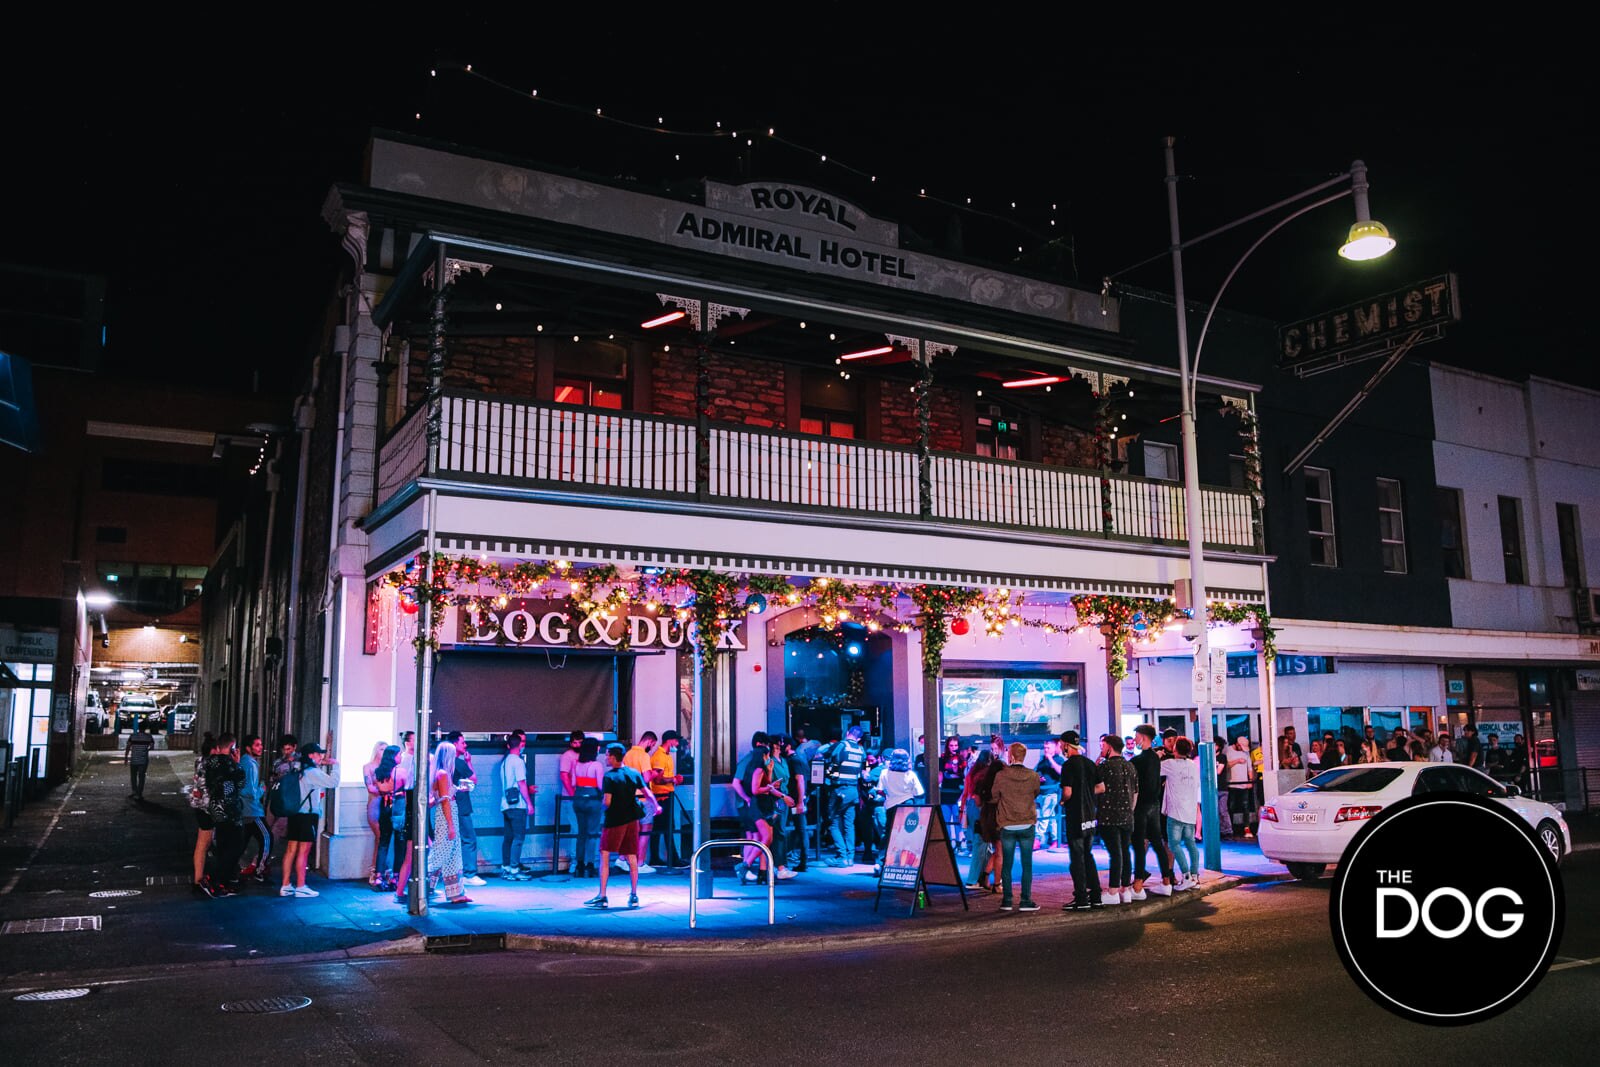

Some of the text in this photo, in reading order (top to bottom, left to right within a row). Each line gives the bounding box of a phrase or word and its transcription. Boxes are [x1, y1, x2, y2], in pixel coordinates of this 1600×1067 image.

[751, 187, 856, 232] ROYAL
[676, 211, 916, 281] ADMIRAL HOTEL
[1284, 281, 1447, 358] CHEMIST
[466, 607, 571, 644] DOG
[578, 611, 622, 646] &
[1478, 723, 1520, 732] MEDICAL CLINIC
